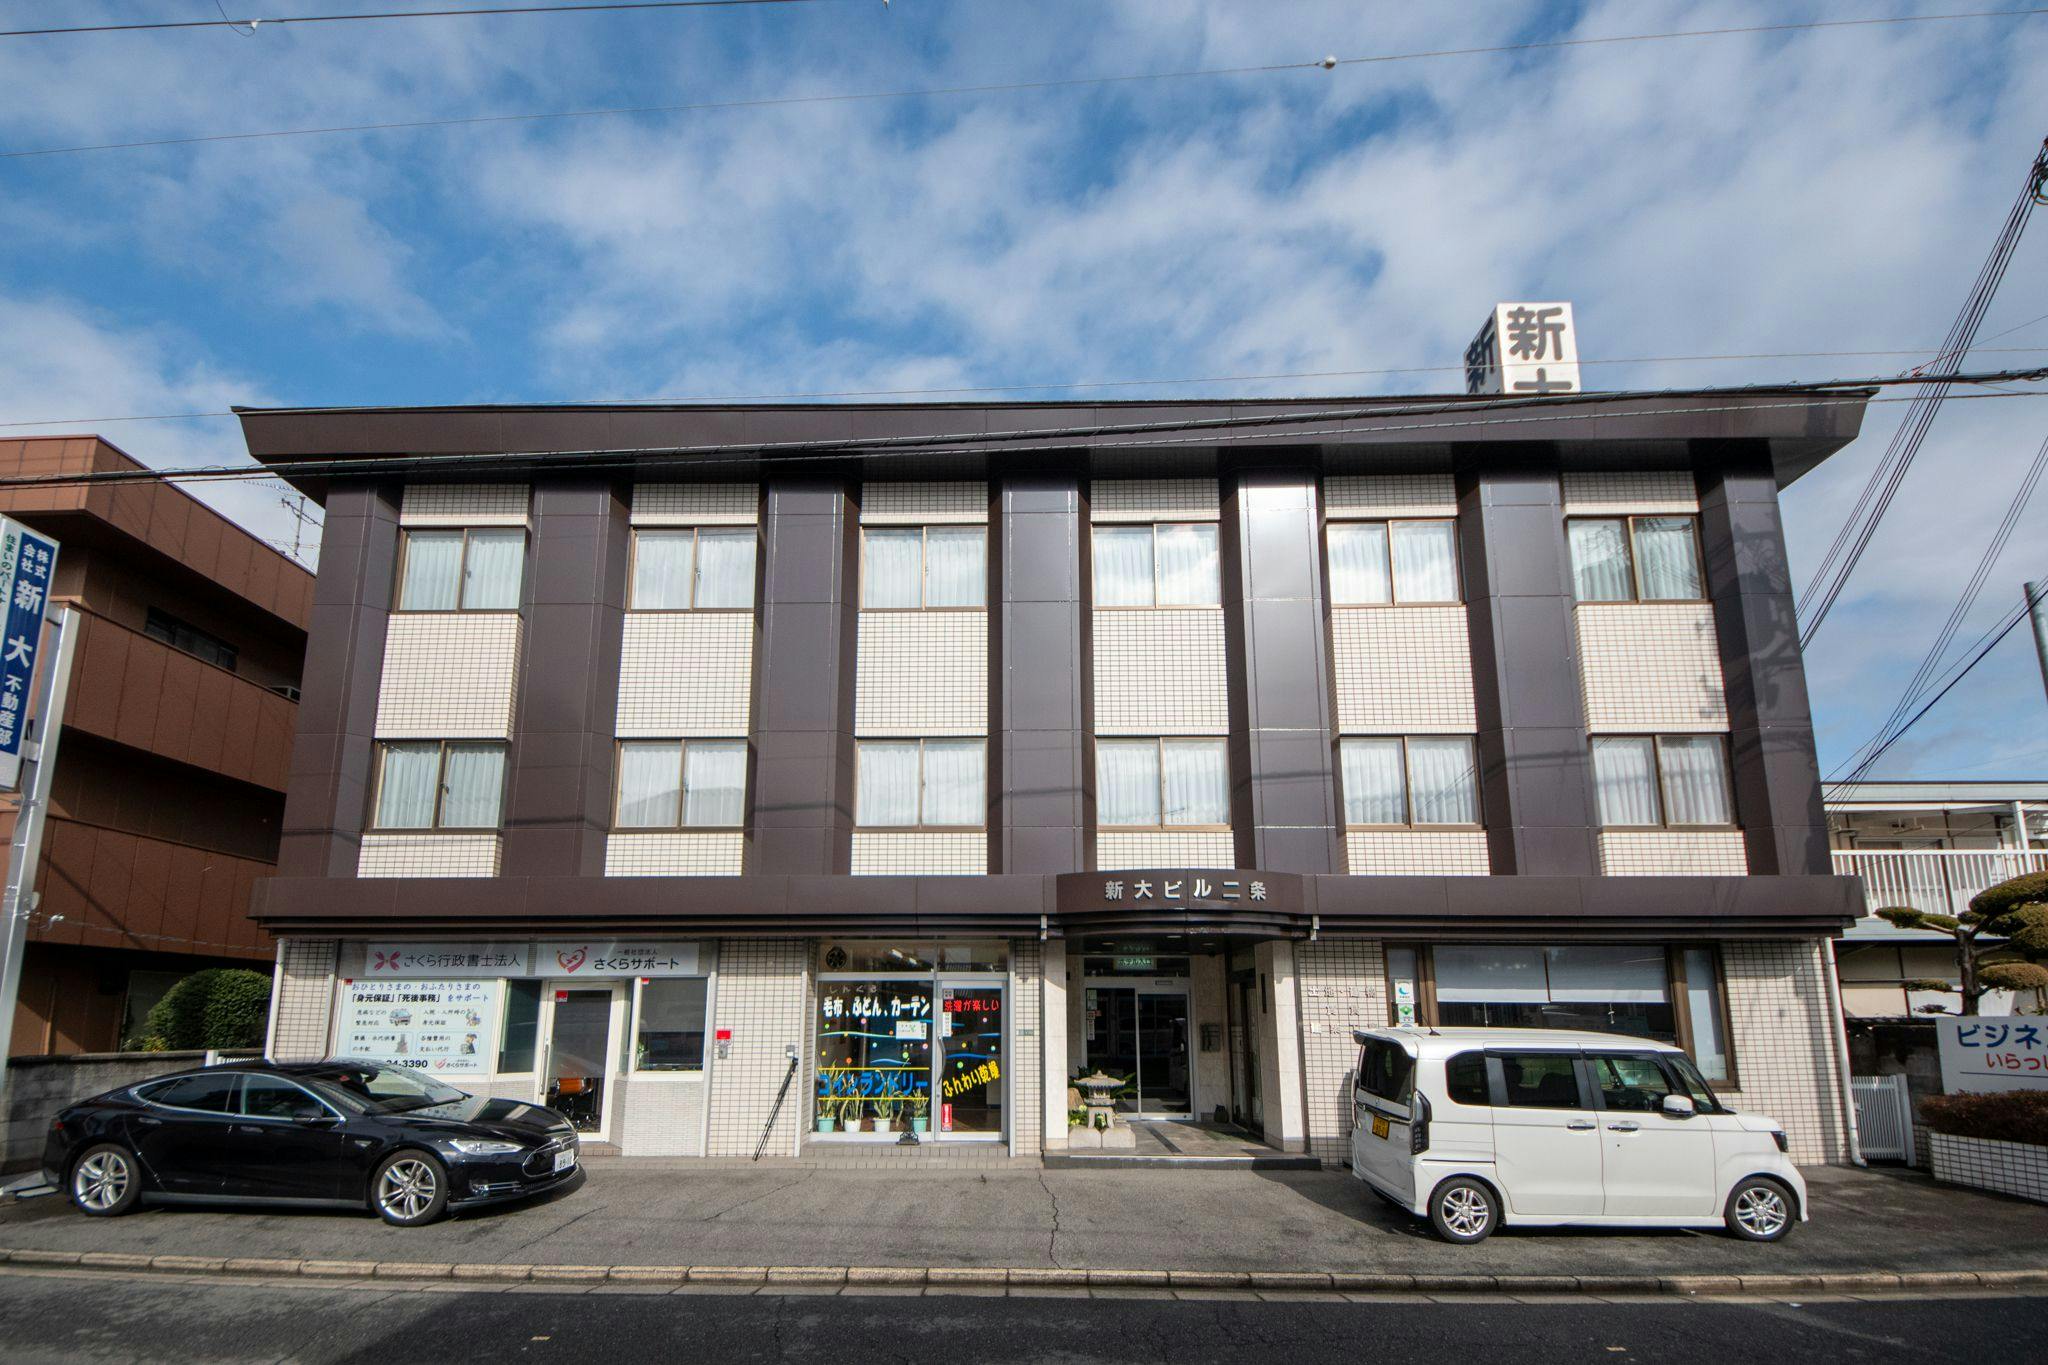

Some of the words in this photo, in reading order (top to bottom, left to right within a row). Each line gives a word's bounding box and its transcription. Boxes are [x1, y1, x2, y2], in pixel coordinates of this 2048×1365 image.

[1105, 879, 1267, 900] 新大ビル二条
[404, 954, 520, 968] さくら行政書士法人
[594, 957, 679, 970] さくらサポート
[823, 995, 930, 1017] 毛布、ふとん、カーテン
[1957, 1024, 2048, 1050] ビジネ
